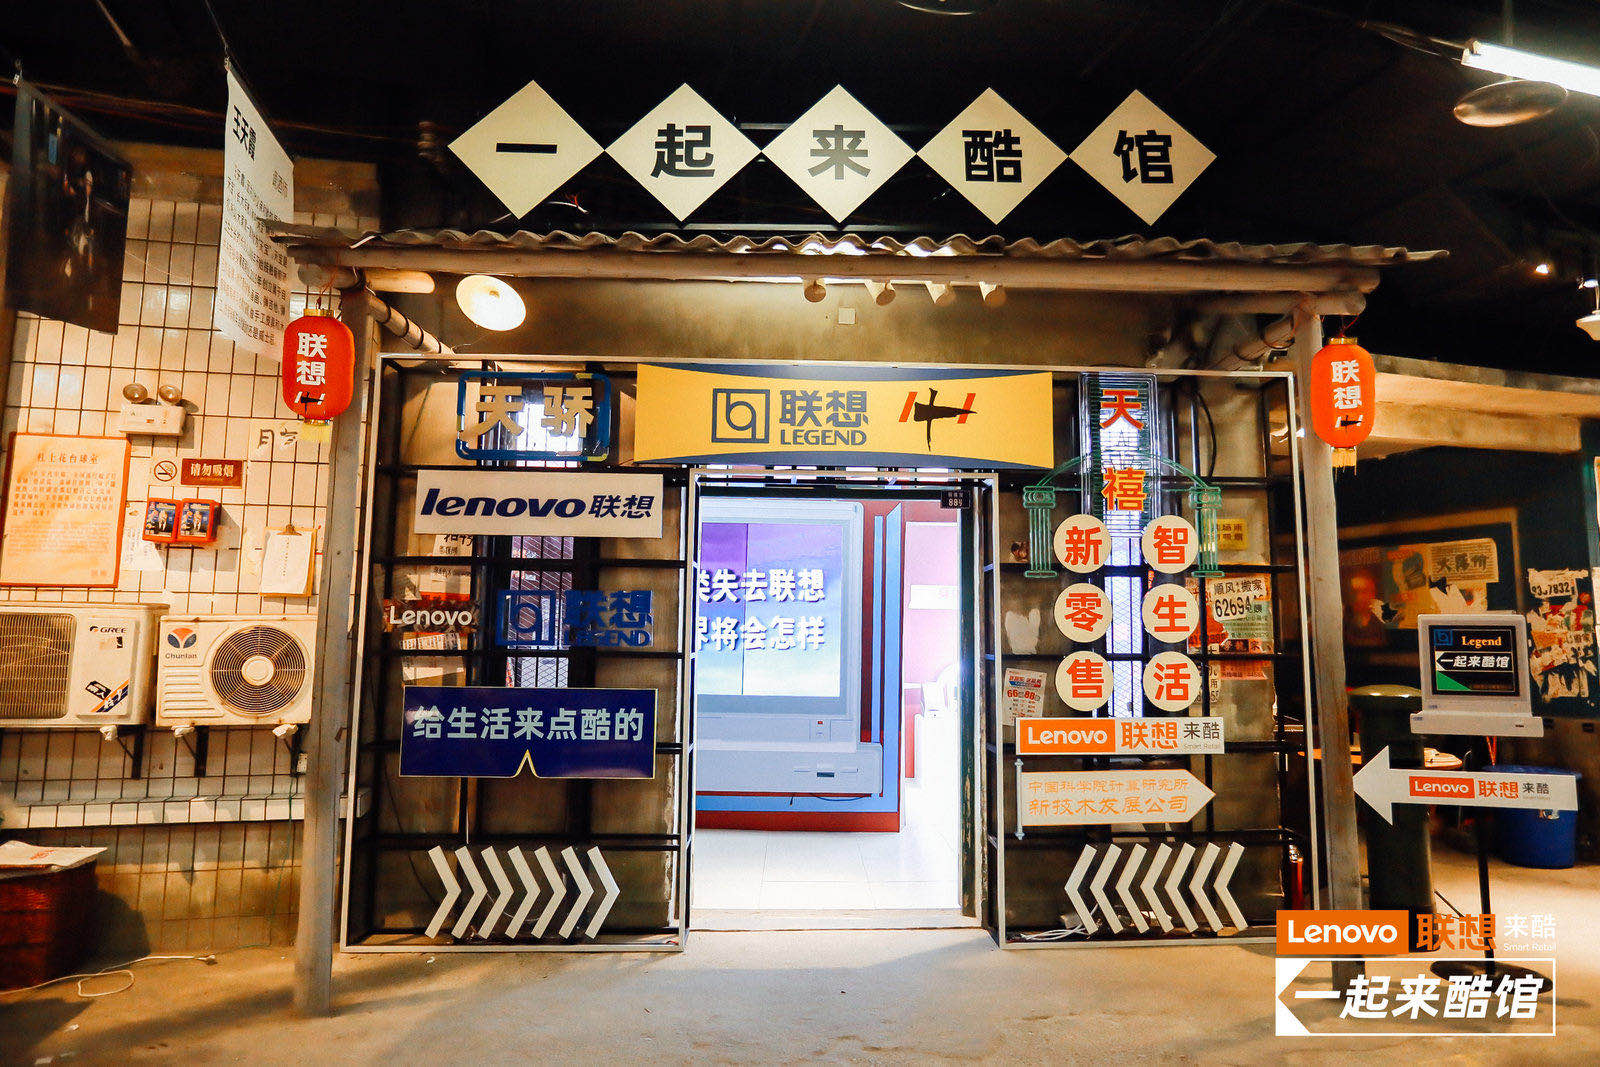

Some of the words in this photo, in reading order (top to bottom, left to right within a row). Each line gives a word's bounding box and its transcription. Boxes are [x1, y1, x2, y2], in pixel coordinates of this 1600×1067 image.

[496, 123, 1174, 186] 一起来酷馆
[297, 332, 327, 386] 联想
[1331, 360, 1362, 410] 联想
[460, 385, 595, 439] 天骄
[779, 389, 869, 428] 联想
[780, 429, 867, 446] LEGEND
[1099, 388, 1147, 512] 天禧
[190, 463, 235, 478] 请勿吸烟
[420, 488, 585, 518] lenovo
[588, 494, 655, 519] 联想
[389, 606, 473, 627] Lenovo
[565, 590, 653, 629] 联想
[1064, 526, 1105, 700] 新零售
[1152, 525, 1191, 701] 智生活
[100, 626, 128, 634] GREE
[1462, 636, 1502, 648] Legend
[165, 652, 198, 660] Chunlan
[1440, 655, 1510, 668] 一起来酷馆
[412, 705, 644, 741] 给生活来点酷的
[1027, 727, 1108, 745] Lenovo
[1120, 722, 1178, 749] 联想
[1183, 722, 1220, 740] 来酷
[1414, 781, 1469, 794] Lenovo
[1478, 780, 1518, 799] 联想
[1522, 782, 1550, 795] 来酷
[1028, 796, 1189, 815] 新技术发展公司
